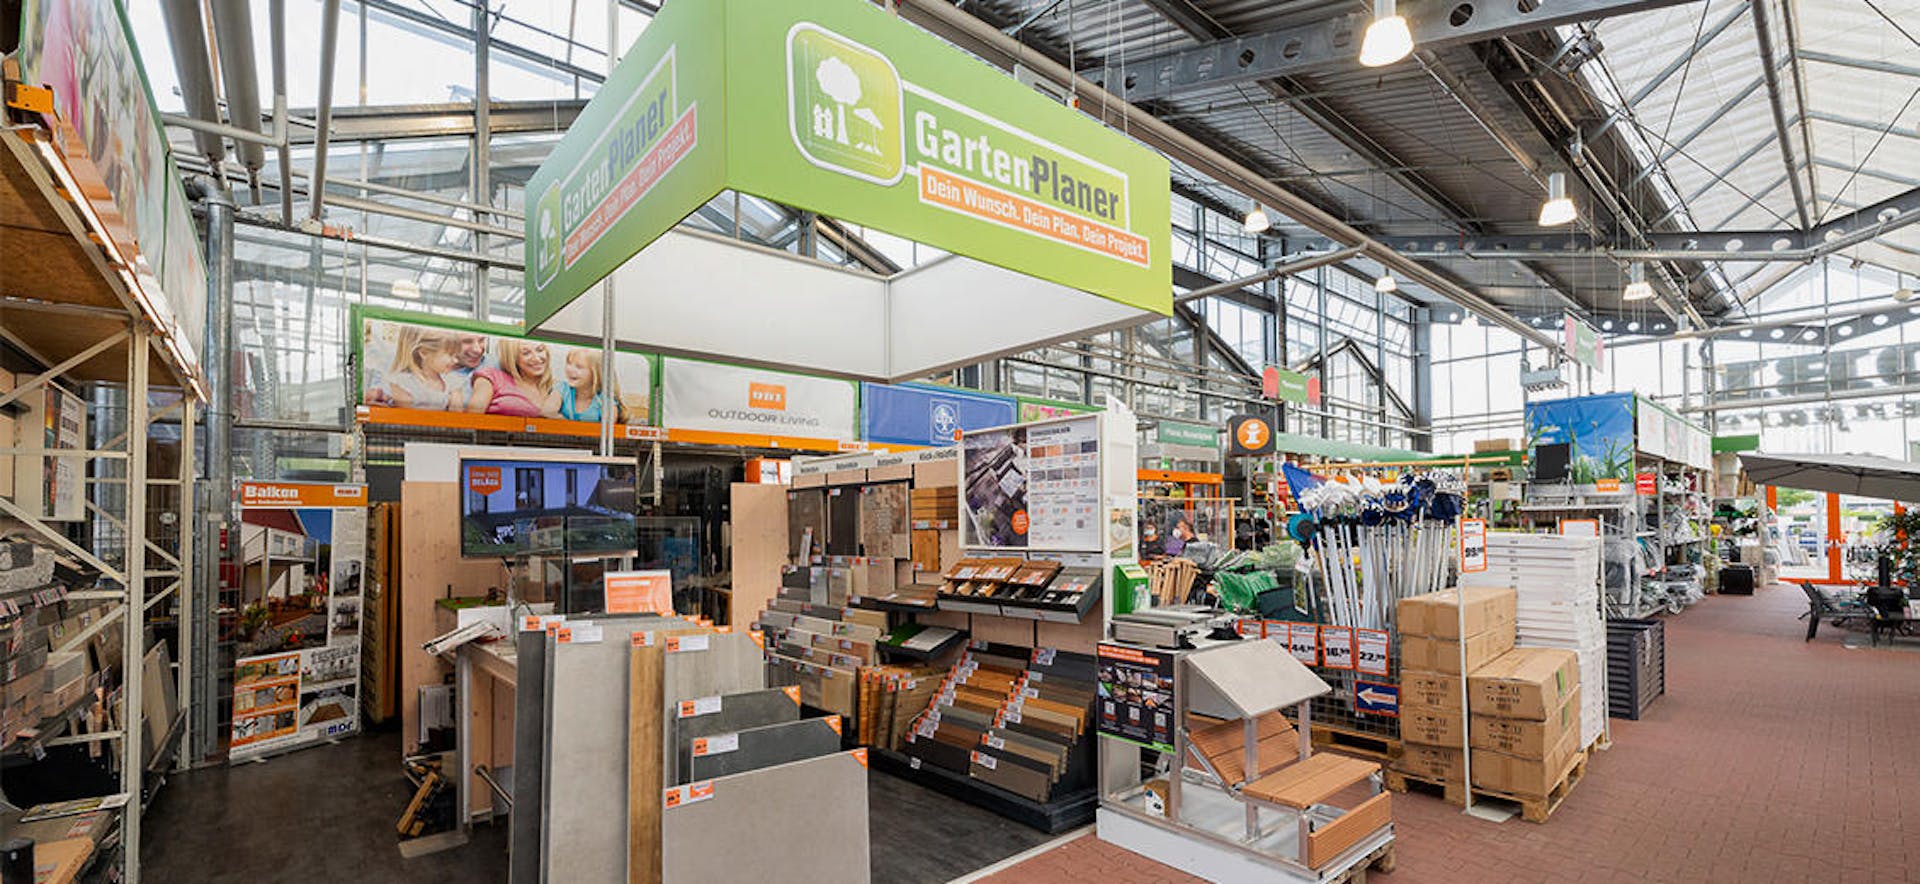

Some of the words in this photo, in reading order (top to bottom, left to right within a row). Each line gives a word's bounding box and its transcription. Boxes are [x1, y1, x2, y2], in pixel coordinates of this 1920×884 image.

[564, 88, 667, 232] GartenPlaner
[915, 110, 1119, 220] GartenPlaner
[927, 175, 960, 203] Dein
[963, 186, 1020, 220] Wunsch.
[1023, 207, 1051, 231] Dein
[1053, 216, 1080, 240] Plan.
[1083, 225, 1106, 248] Dein
[1107, 233, 1146, 259] Projekt.
[708, 408, 777, 425] OUTDOOR
[780, 415, 820, 427] LIVING
